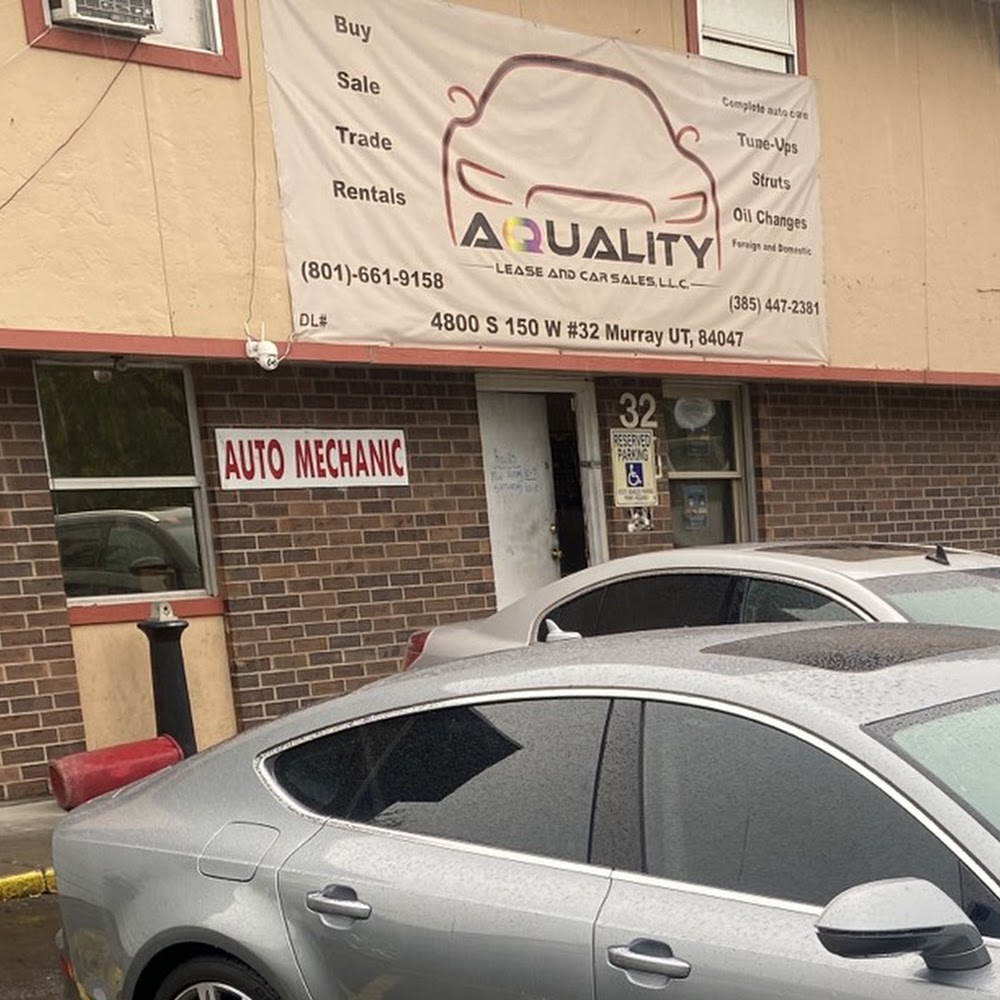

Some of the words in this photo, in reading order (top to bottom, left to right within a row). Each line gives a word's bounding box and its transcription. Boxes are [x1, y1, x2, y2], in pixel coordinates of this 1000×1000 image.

[334, 15, 371, 43] Buy
[337, 71, 381, 95] Sale
[722, 96, 765, 114] Complete
[767, 106, 788, 118] auto
[335, 126, 393, 151] Trade
[737, 132, 799, 157] Tune-Ups
[333, 180, 407, 206] Rentals
[752, 171, 792, 191] Struts
[733, 207, 752, 223] Oil
[756, 210, 808, 232] Changes
[460, 211, 714, 269] AQUALITY
[732, 238, 762, 253] Foreign
[778, 243, 812, 256] Domestic
[301, 260, 444, 289] (801)-661-9158
[495, 263, 544, 278] LEASE
[580, 271, 611, 283] CAR
[729, 294, 761, 315] (385)
[765, 299, 820, 316] 447-2381
[299, 313, 328, 328] DL#
[431, 312, 479, 333] 4800
[487, 316, 499, 334] S
[506, 318, 539, 337] 150
[545, 320, 562, 337] W
[567, 322, 600, 341] #32
[605, 323, 664, 347] Murray
[669, 328, 694, 349] UT,
[698, 330, 744, 348] 84047
[619, 392, 658, 429] 32
[613, 434, 651, 448] RESERVED
[225, 438, 285, 481] AUTO
[295, 438, 404, 479] MECHANIC
[617, 448, 649, 462] PARKING
